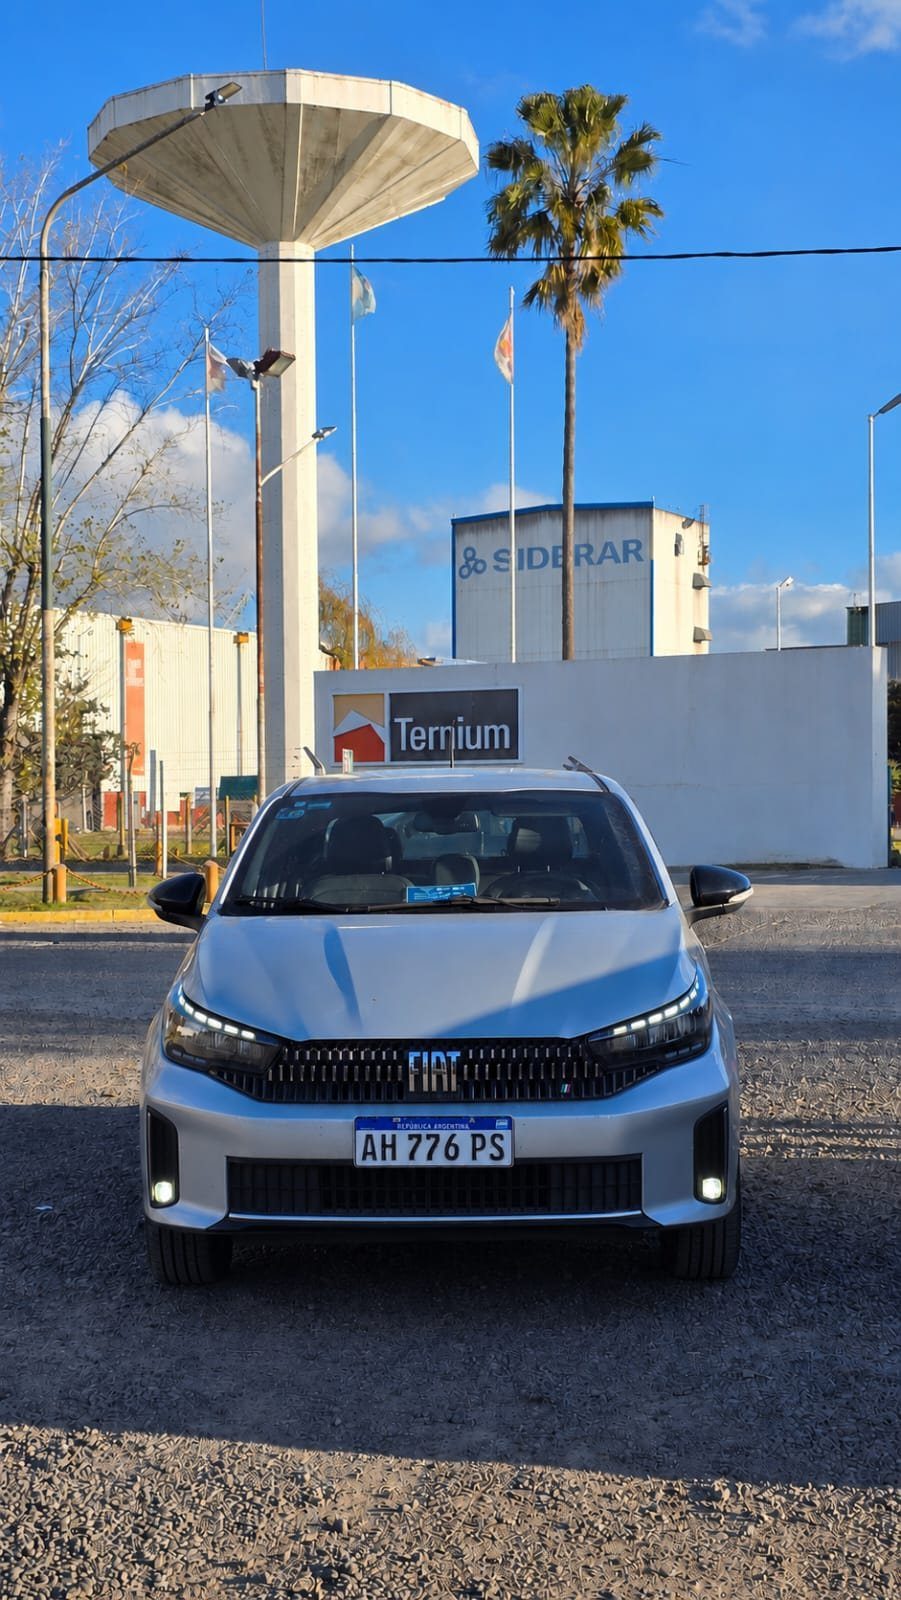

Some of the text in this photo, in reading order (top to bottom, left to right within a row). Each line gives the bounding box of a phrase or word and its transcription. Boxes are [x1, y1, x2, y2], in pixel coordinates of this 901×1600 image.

[394, 716, 510, 751] Ternium
[408, 1051, 461, 1092] FIAT
[434, 1122, 470, 1130] ARGENTINA
[361, 1133, 505, 1161] AH 776 PS
